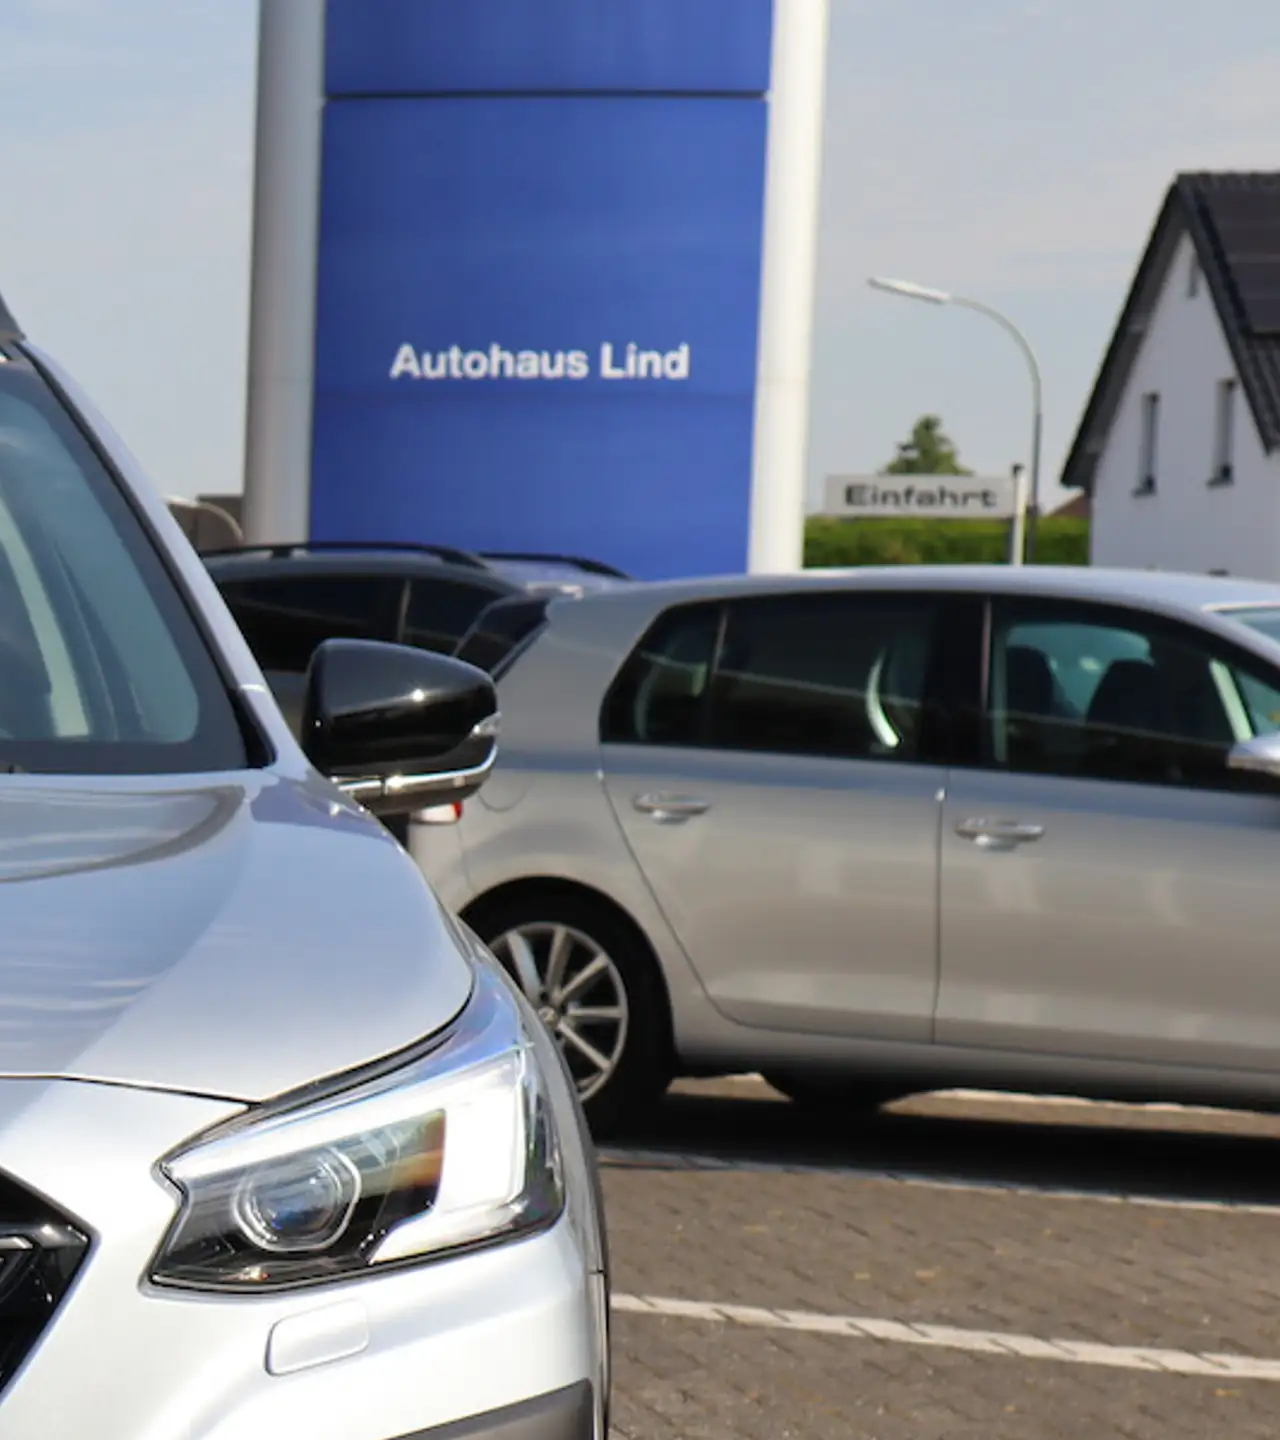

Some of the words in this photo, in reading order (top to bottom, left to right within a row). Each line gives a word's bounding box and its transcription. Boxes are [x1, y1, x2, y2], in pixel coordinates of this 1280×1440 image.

[390, 342, 589, 379] Autohaus
[600, 341, 690, 378] Lind
[844, 484, 998, 509] Einfahrt
